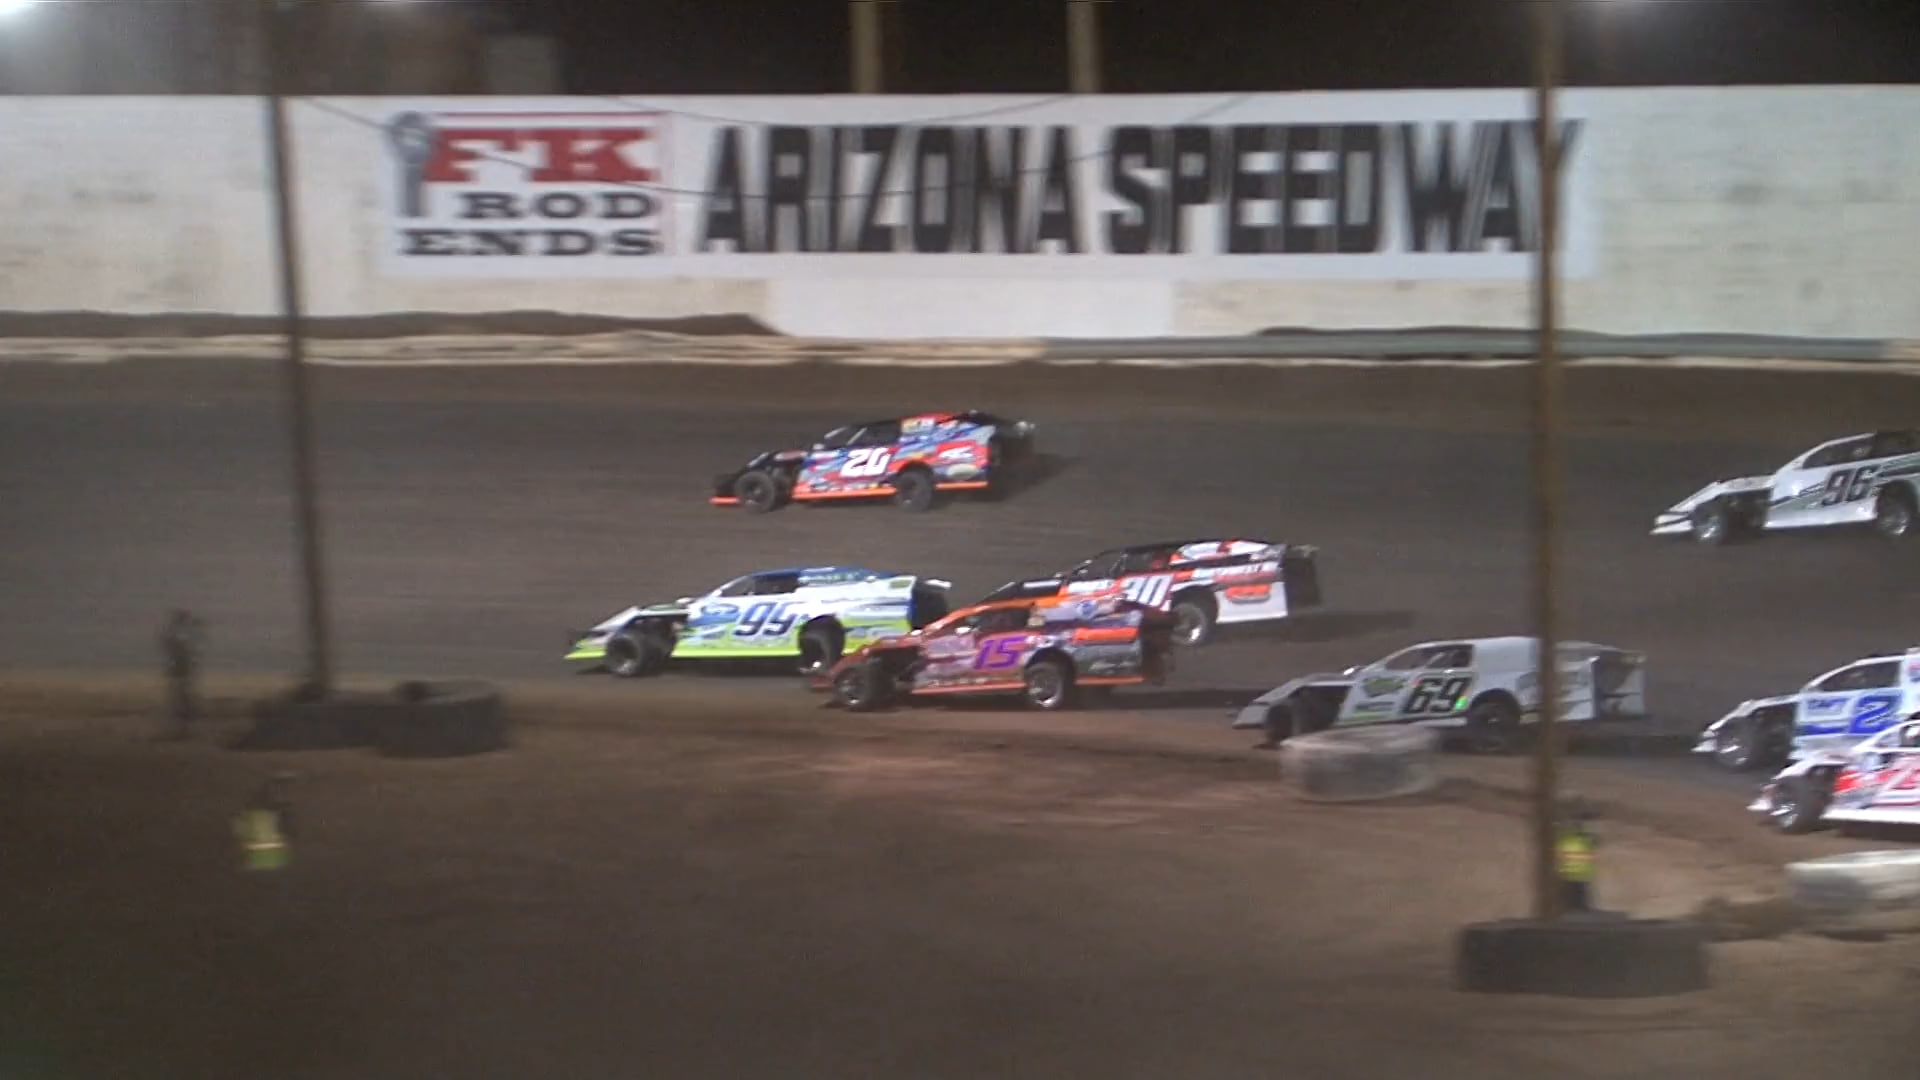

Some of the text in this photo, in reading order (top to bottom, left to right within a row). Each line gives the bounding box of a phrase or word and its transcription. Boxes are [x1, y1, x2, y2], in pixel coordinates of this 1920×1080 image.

[700, 119, 1586, 254] ARIZONA SPEEDWAY
[459, 191, 656, 220] ROD
[399, 229, 660, 257] ENDS
[842, 446, 892, 478] 20
[1822, 466, 1878, 506] 96
[733, 600, 802, 637] 99
[975, 635, 1029, 670] 15
[1406, 675, 1472, 713] 69
